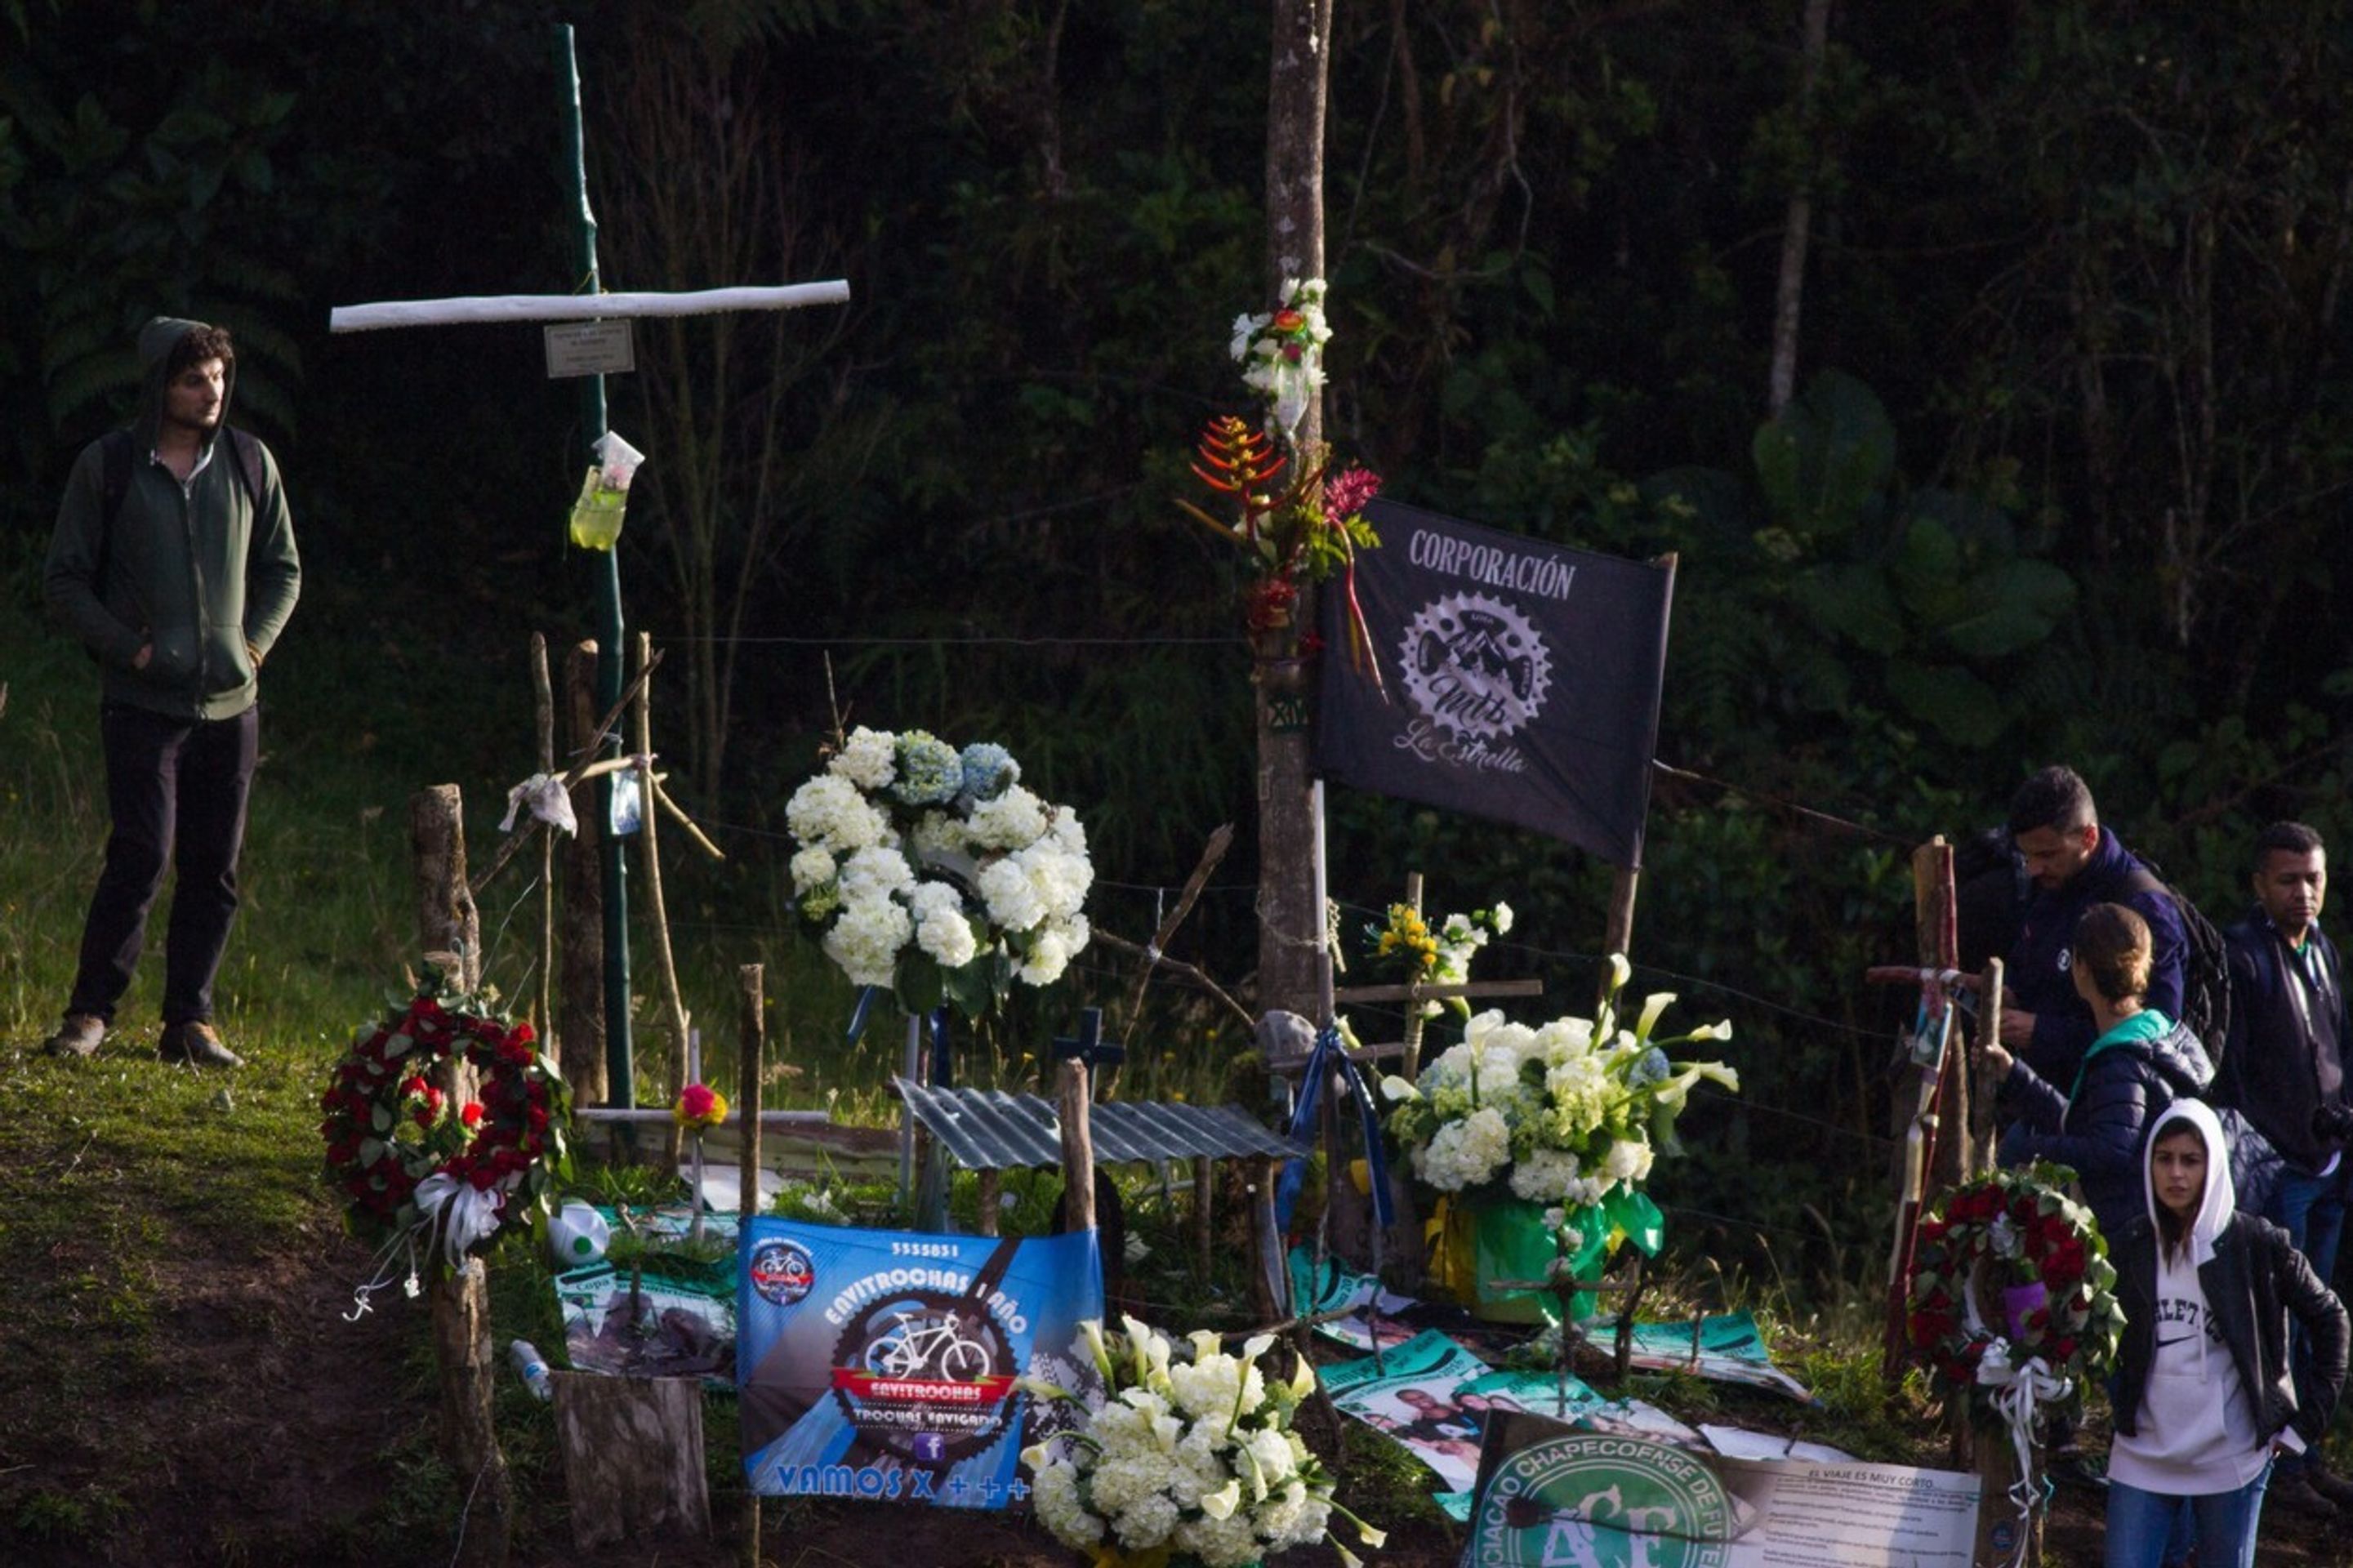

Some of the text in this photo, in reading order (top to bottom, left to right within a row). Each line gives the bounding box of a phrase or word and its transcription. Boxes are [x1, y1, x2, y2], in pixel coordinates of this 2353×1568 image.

[1410, 529, 1576, 600] CORPORACIÓN
[1393, 719, 1527, 774] La Estrella
[576, 1278, 610, 1292] Copa
[824, 1267, 970, 1325] ENVITROCHAS
[987, 1288, 1027, 1334] AÑO
[870, 1382, 983, 1401] ENVITROCHAS
[853, 1408, 922, 1423] TROCHAS
[778, 1464, 903, 1499] VAMOS
[911, 1468, 936, 1499] X
[1515, 1440, 1696, 1483] CHAPECOENSE
[1688, 1477, 1717, 1509] DE
[1808, 1469, 1820, 1477] EL
[1824, 1469, 1852, 1480] VIAJE
[1855, 1471, 1867, 1481] ES
[1869, 1472, 1896, 1484] MUY
